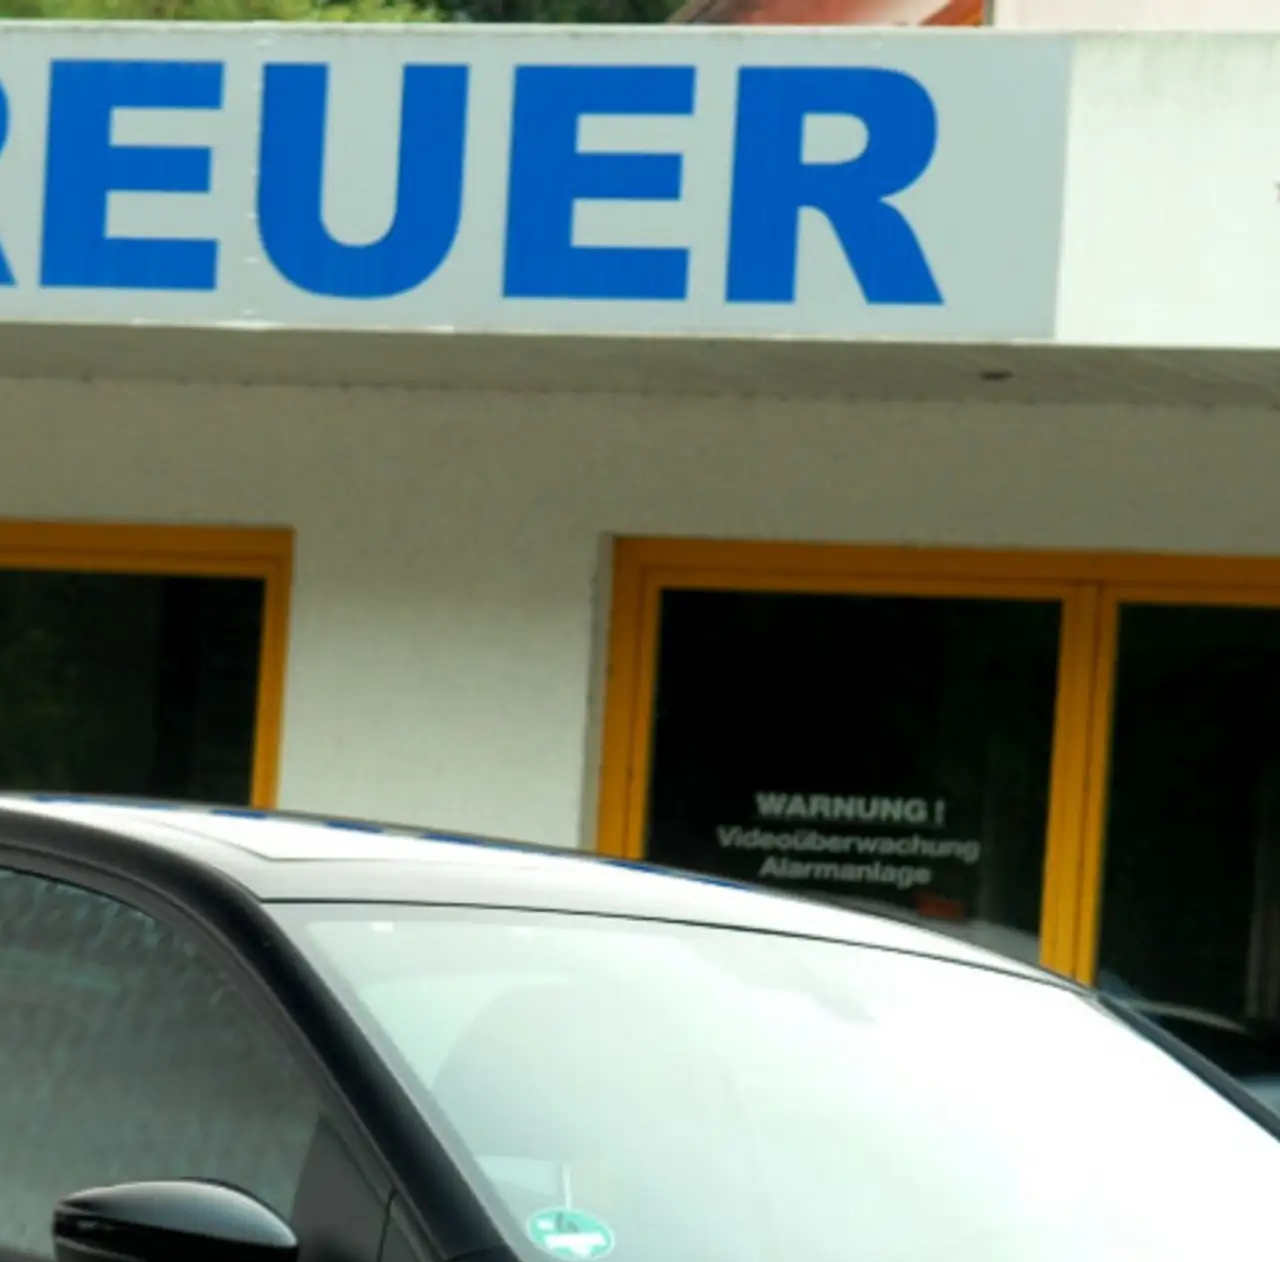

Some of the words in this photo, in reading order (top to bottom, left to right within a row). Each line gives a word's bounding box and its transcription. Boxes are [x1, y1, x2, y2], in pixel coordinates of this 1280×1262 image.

[756, 792, 927, 822] WARNUNG
[717, 826, 980, 863] Videoüberwachung
[760, 856, 932, 888] Alarmanlage
